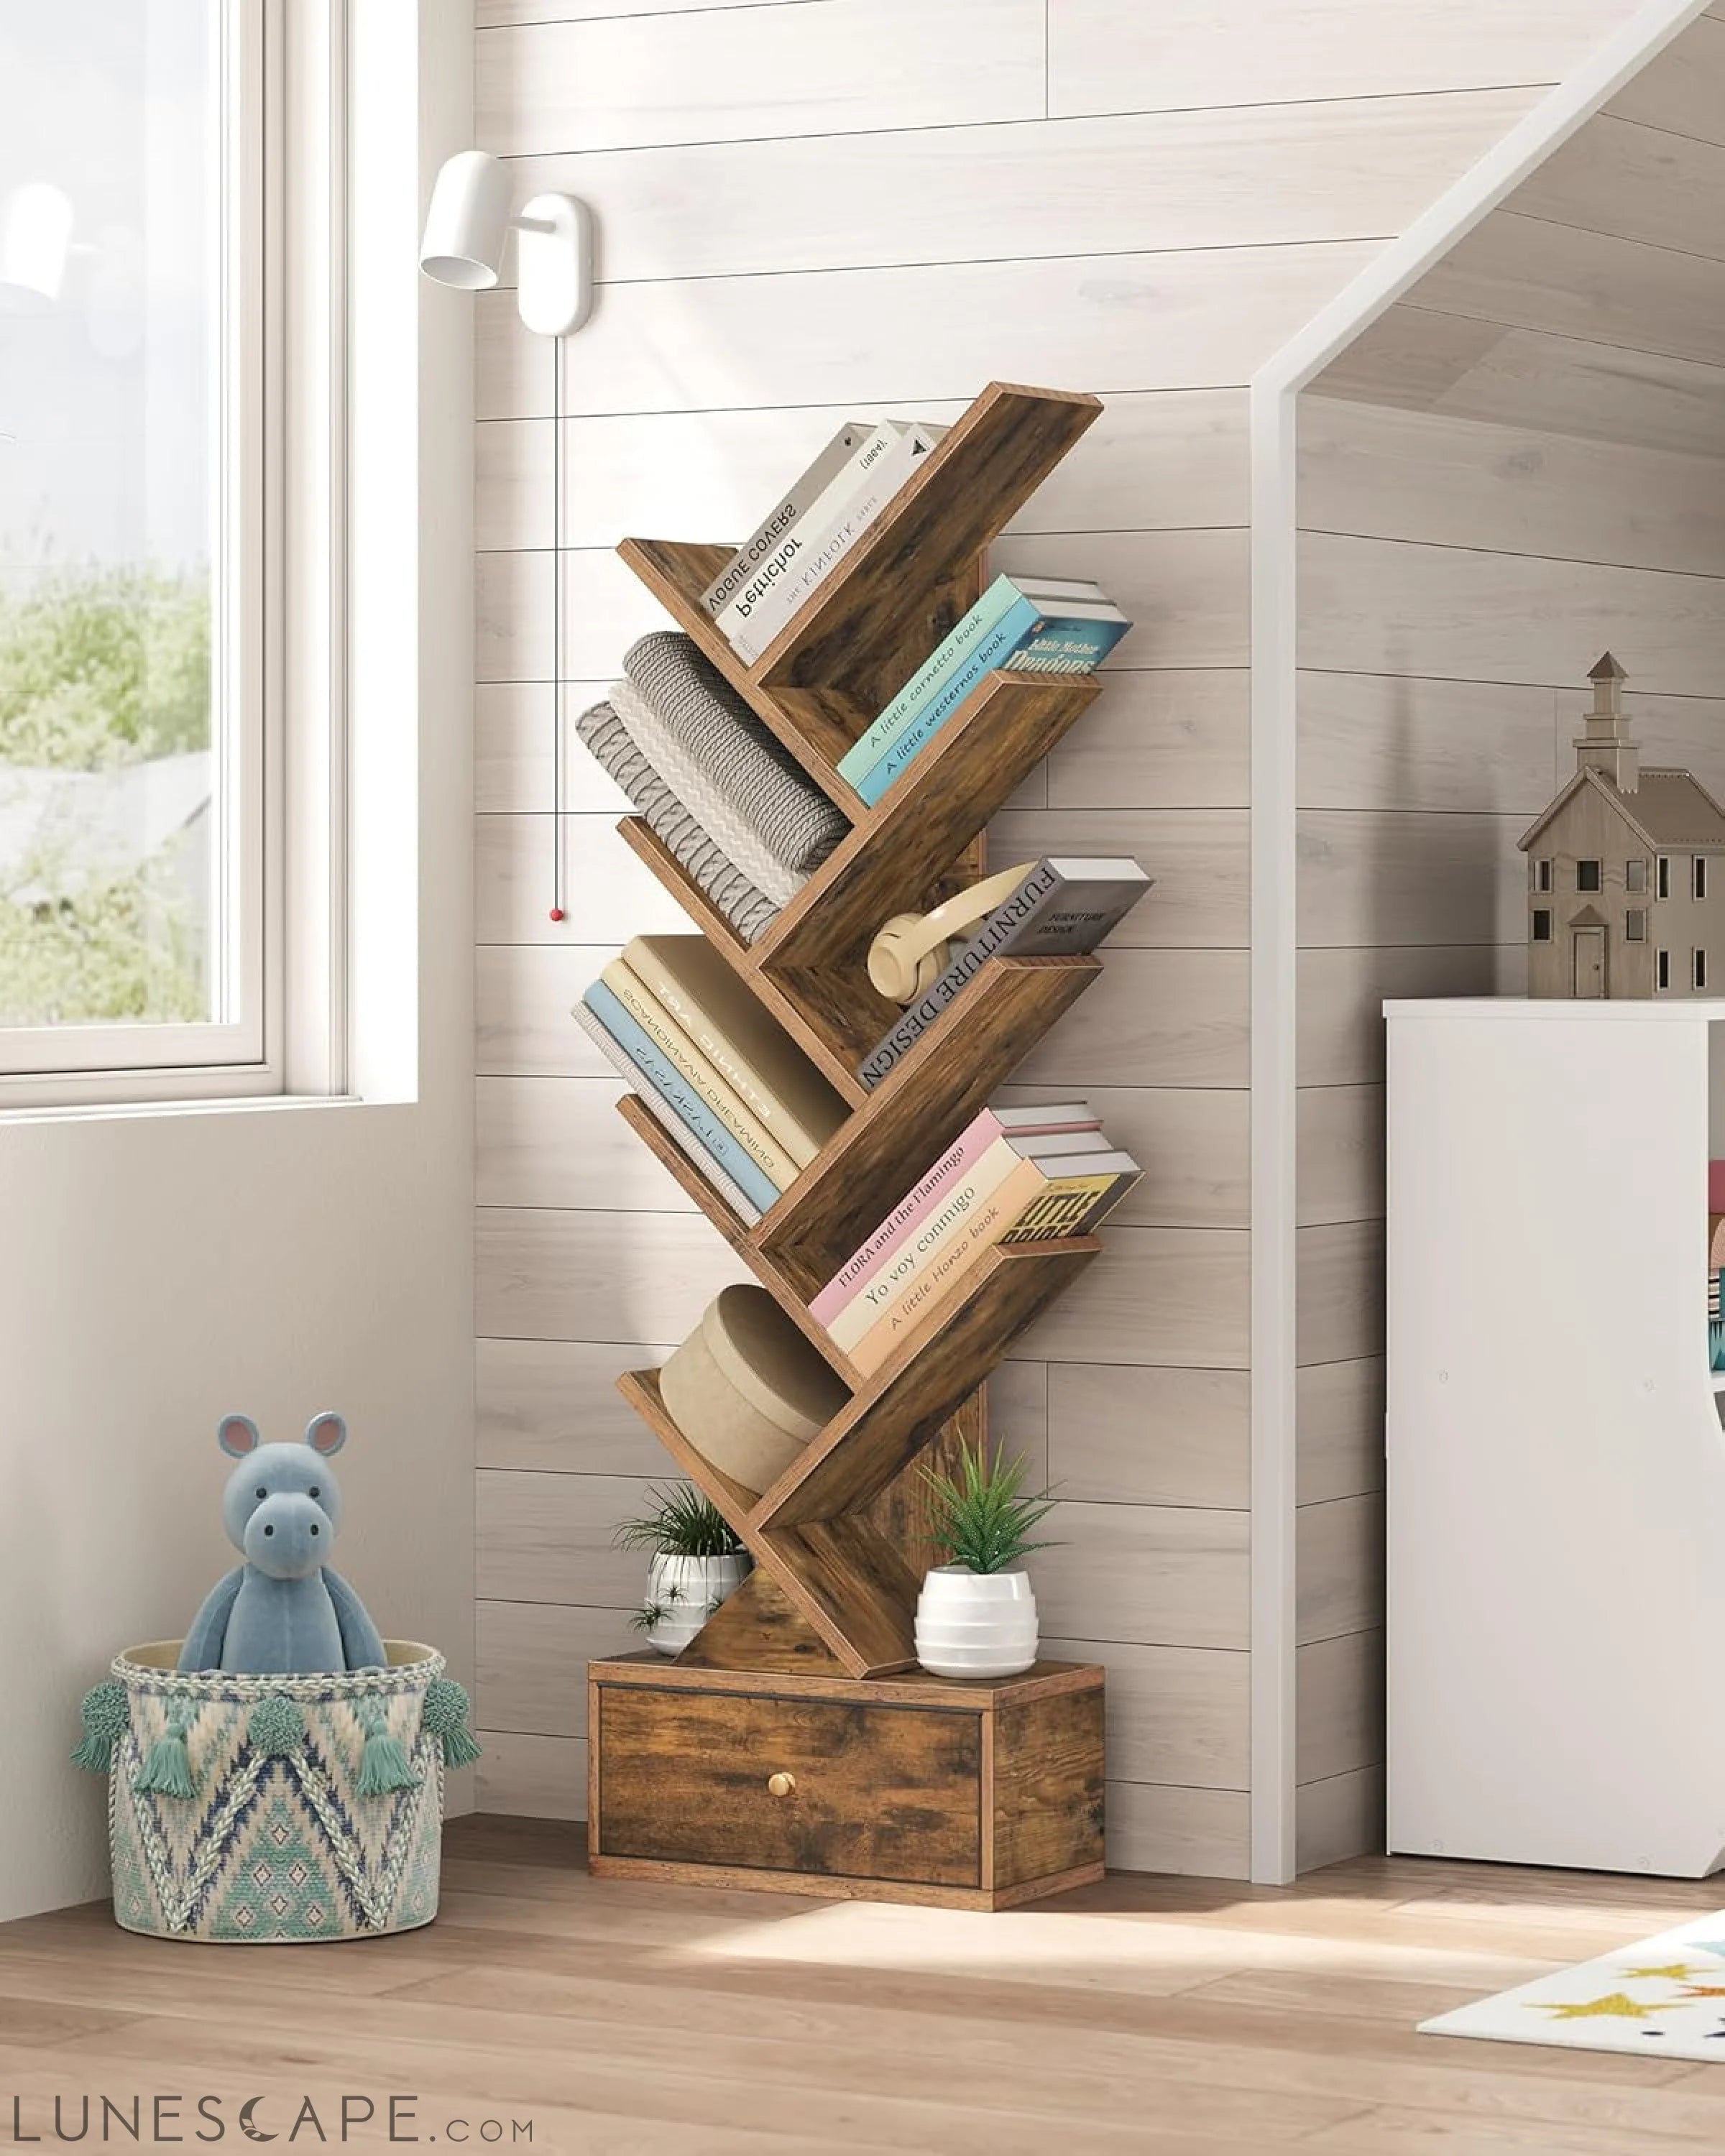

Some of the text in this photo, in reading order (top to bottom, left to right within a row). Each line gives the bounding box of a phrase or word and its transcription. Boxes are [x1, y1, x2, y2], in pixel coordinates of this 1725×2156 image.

[870, 614, 983, 748] A little cornetto book
[887, 632, 1007, 775] A little westernos book
[862, 867, 1056, 1087] FURNITURE DESIGN
[840, 1146, 965, 1287] FLORA and the Flamingo
[865, 1187, 975, 1304] Yo voy conmigo
[891, 1207, 1000, 1330] A little Honzo book
